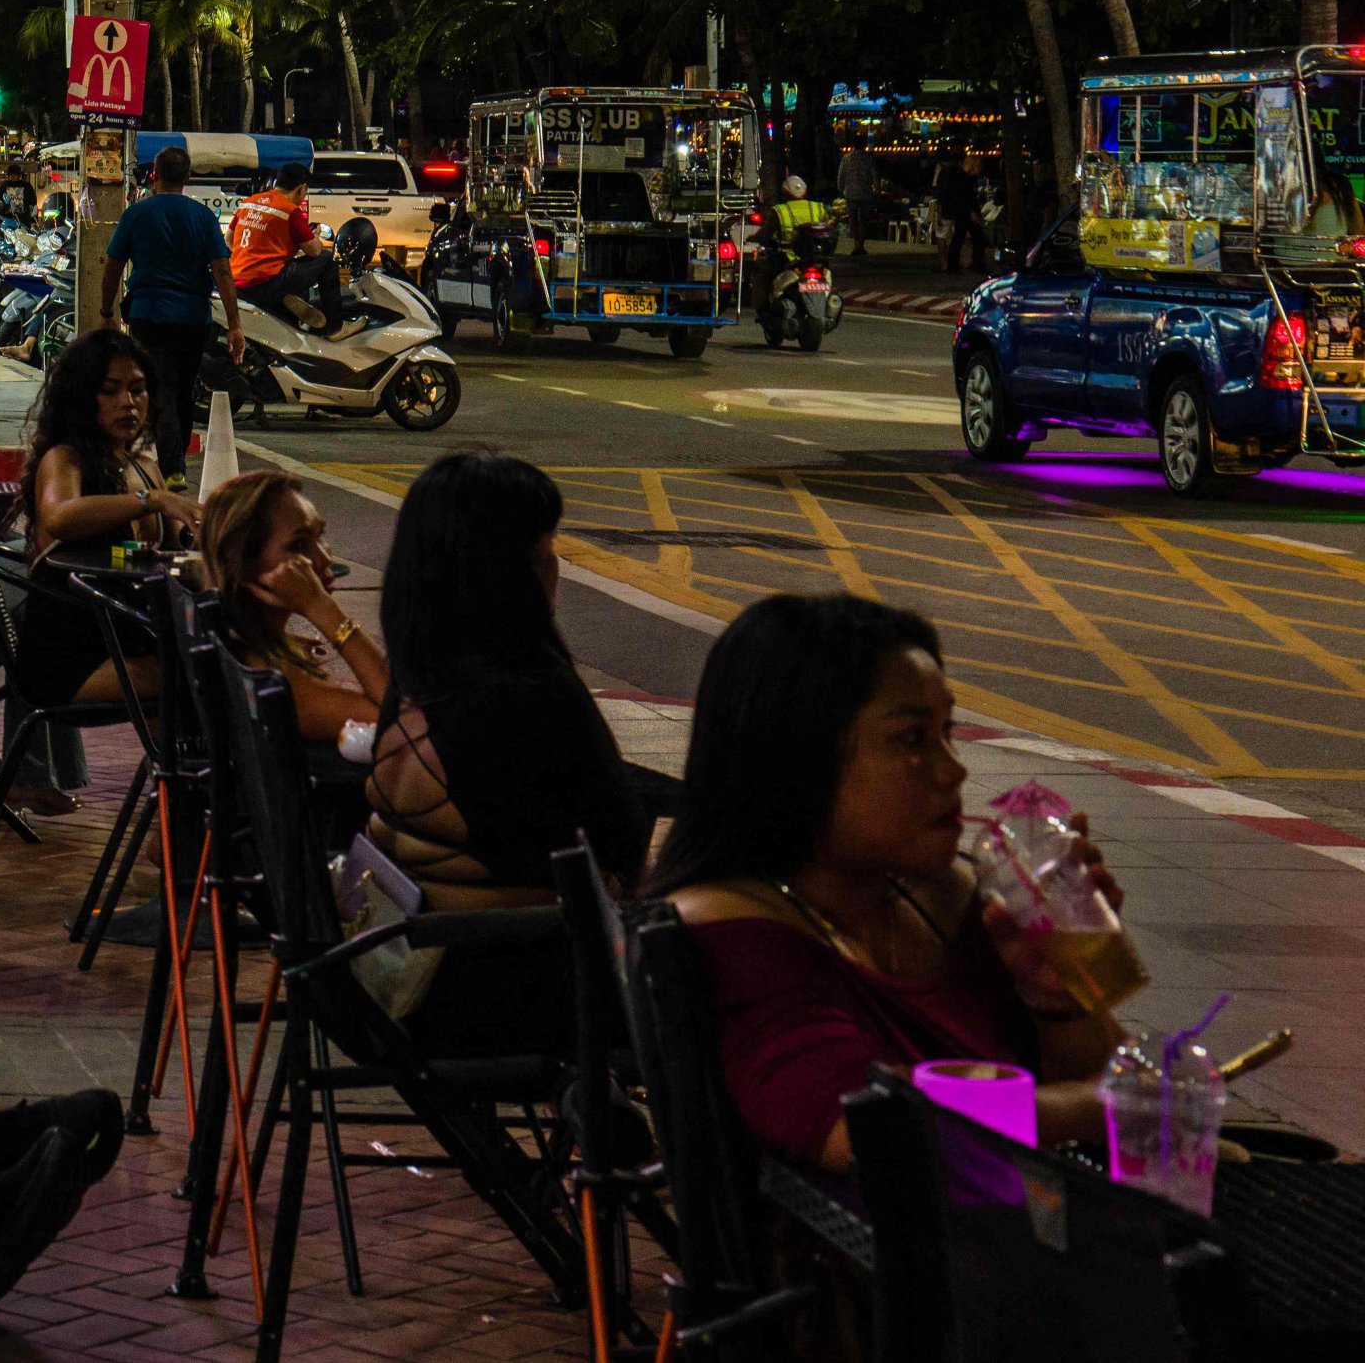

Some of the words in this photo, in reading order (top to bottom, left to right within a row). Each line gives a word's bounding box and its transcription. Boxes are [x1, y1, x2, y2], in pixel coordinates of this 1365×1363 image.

[84, 99, 99, 108] Lido
[99, 101, 126, 111] Pattaya
[88, 113, 103, 124] 24
[105, 116, 124, 124] hours
[508, 109, 575, 129] BSS
[577, 109, 641, 130] CLUB
[609, 300, 653, 312] 10-5854
